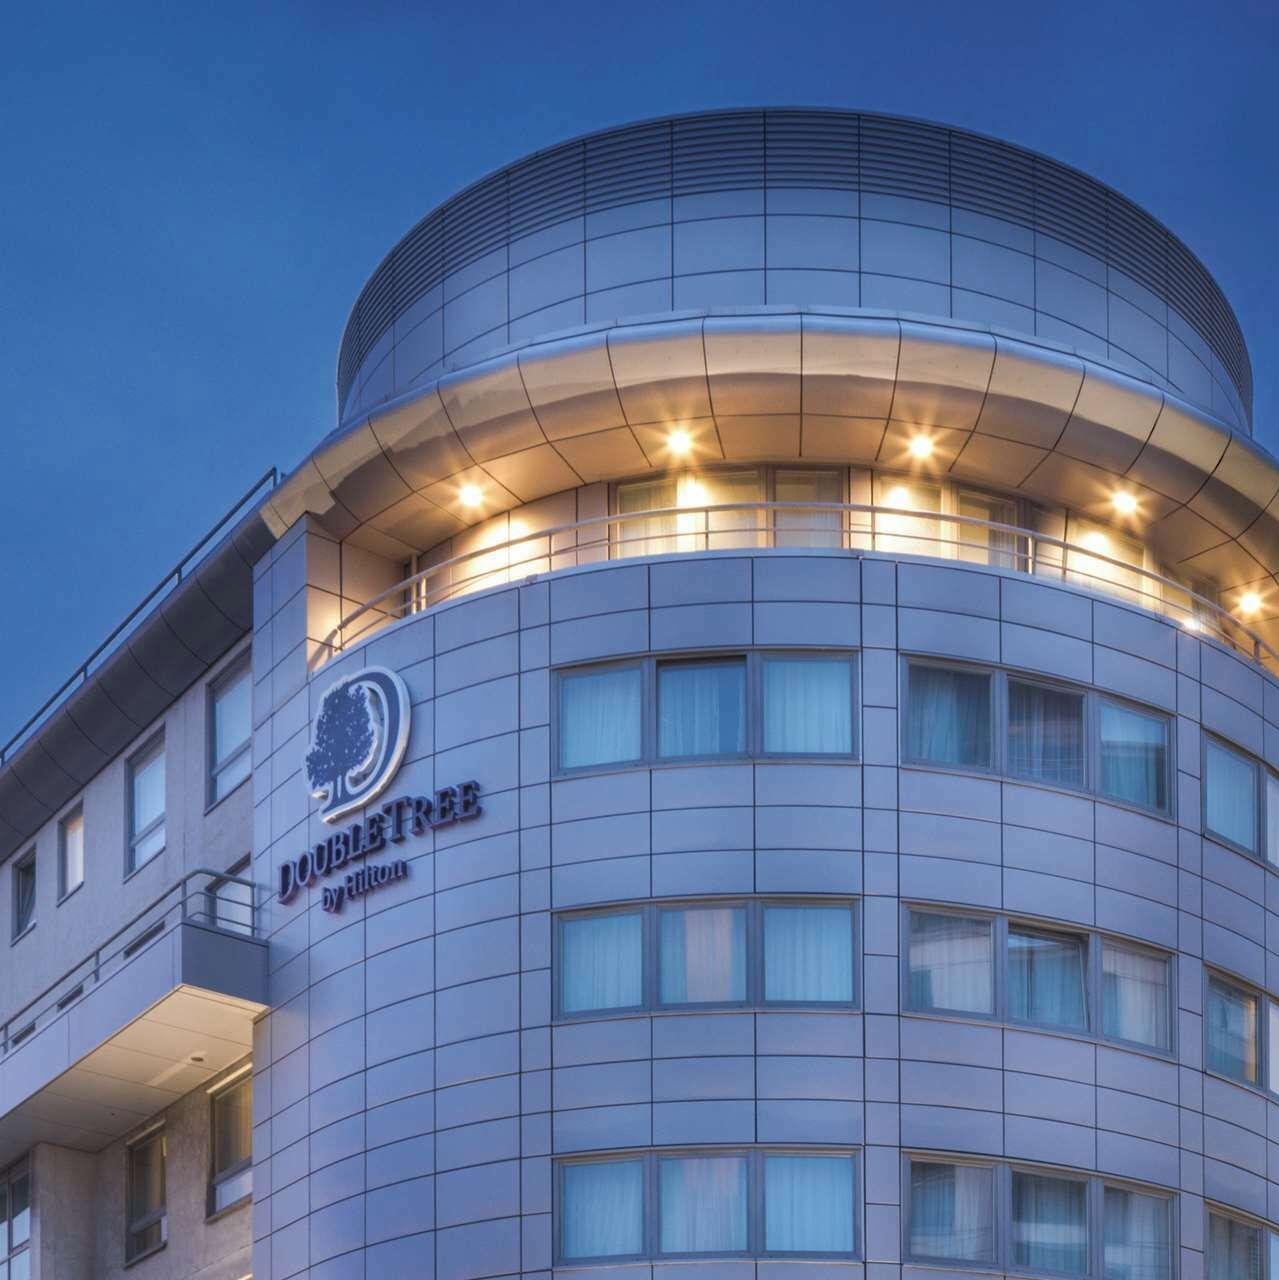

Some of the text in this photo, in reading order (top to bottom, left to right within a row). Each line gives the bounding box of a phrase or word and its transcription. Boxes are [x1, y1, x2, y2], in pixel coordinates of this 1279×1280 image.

[278, 779, 483, 904] DOUBLETREE
[322, 859, 409, 914] by Hilton
